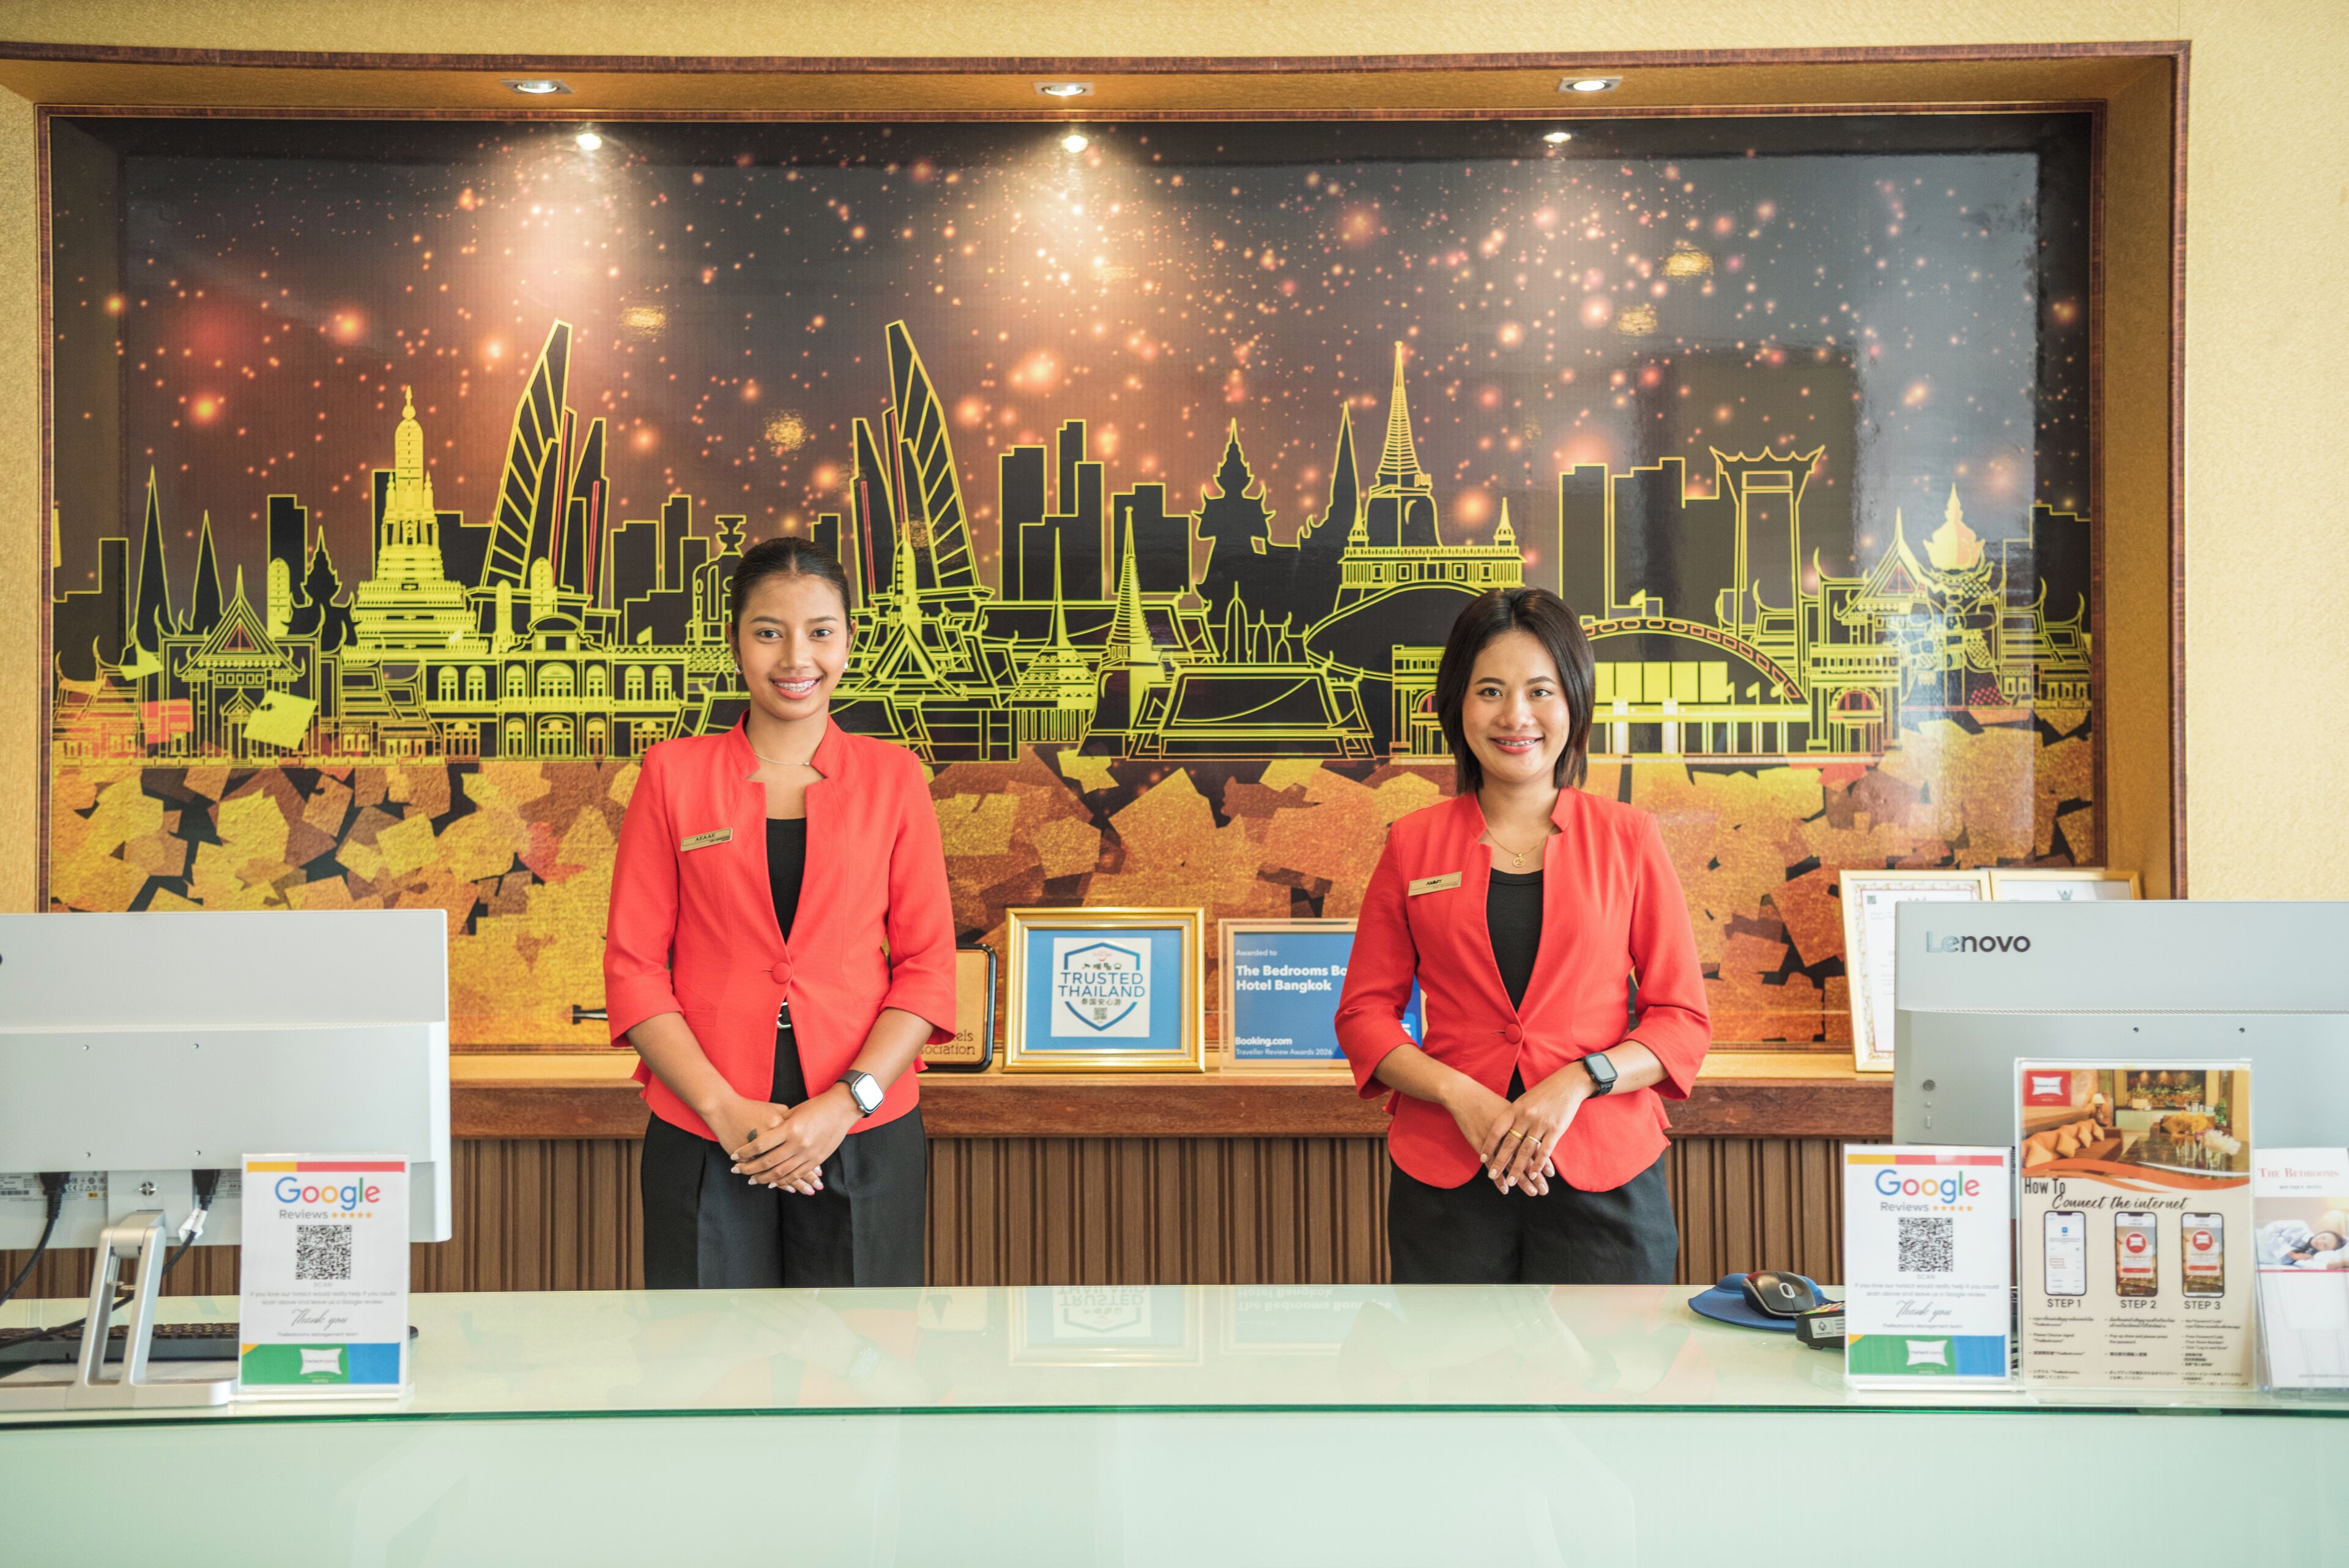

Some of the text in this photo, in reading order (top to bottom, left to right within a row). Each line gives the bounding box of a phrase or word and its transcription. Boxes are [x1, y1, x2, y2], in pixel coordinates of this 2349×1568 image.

[1926, 931, 2032, 953] Lenovo
[1235, 965, 1260, 976] The
[1263, 965, 1329, 976] Bedrooms
[1060, 972, 1143, 984] TRUSTED
[1058, 985, 1145, 997] THAILAND
[1236, 979, 1332, 993] Hotel Bangkok
[1234, 1036, 1293, 1047] Booking.com
[2257, 1167, 2340, 1178] THE BEDROOMS
[1875, 1169, 1980, 1204] Google
[2024, 1177, 2066, 1194] How To
[275, 1176, 381, 1211] Google
[1880, 1202, 1929, 1212] Reviews
[2052, 1194, 2192, 1210] Connect the internet
[279, 1209, 328, 1219] Reviews
[2047, 1298, 2081, 1308] STEP 1
[2120, 1299, 2157, 1309] STEP 2
[2184, 1301, 2221, 1310] STEP 3
[1896, 1299, 1953, 1323] Thank you
[291, 1307, 349, 1331] Thank you
